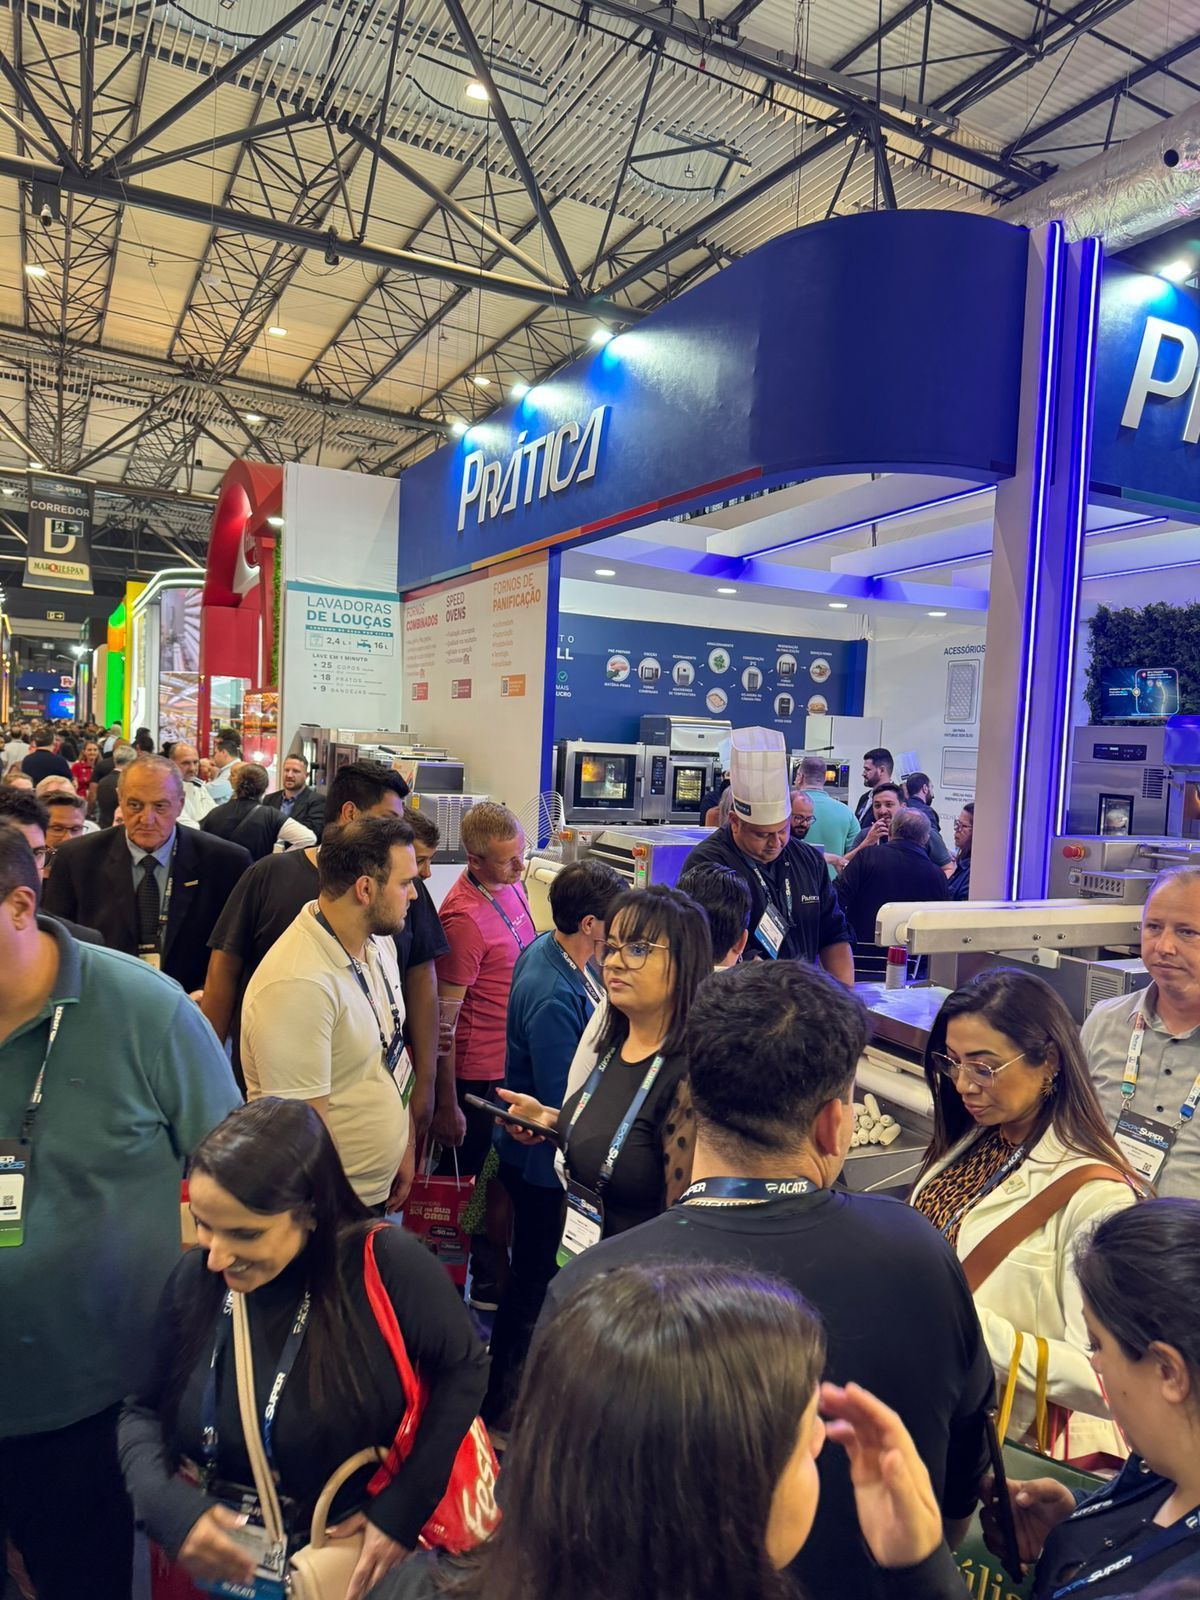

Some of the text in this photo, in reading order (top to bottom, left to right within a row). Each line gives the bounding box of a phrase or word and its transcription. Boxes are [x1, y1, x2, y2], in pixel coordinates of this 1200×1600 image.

[457, 404, 606, 531] PRÁTICA
[30, 500, 90, 517] CORREDOR
[44, 517, 76, 554] D
[33, 561, 84, 575] MARQUESPAN
[493, 572, 534, 596] FORNOS DE
[307, 595, 392, 615] LAVADORAS
[446, 592, 465, 608] SPEED
[492, 586, 541, 612] PANIFICAÇÃO
[307, 610, 392, 629] DE LOUÇAS
[406, 614, 439, 631] COMBINADOS
[446, 606, 466, 622] OVENS
[326, 637, 341, 645] 2,4
[944, 645, 986, 655] ACESSÓRIOS
[321, 661, 332, 669] 25
[336, 664, 361, 672] COPOS
[320, 673, 331, 681] 18
[778, 1181, 808, 1194] ACATS
[264, 1371, 287, 1420] SUPER
